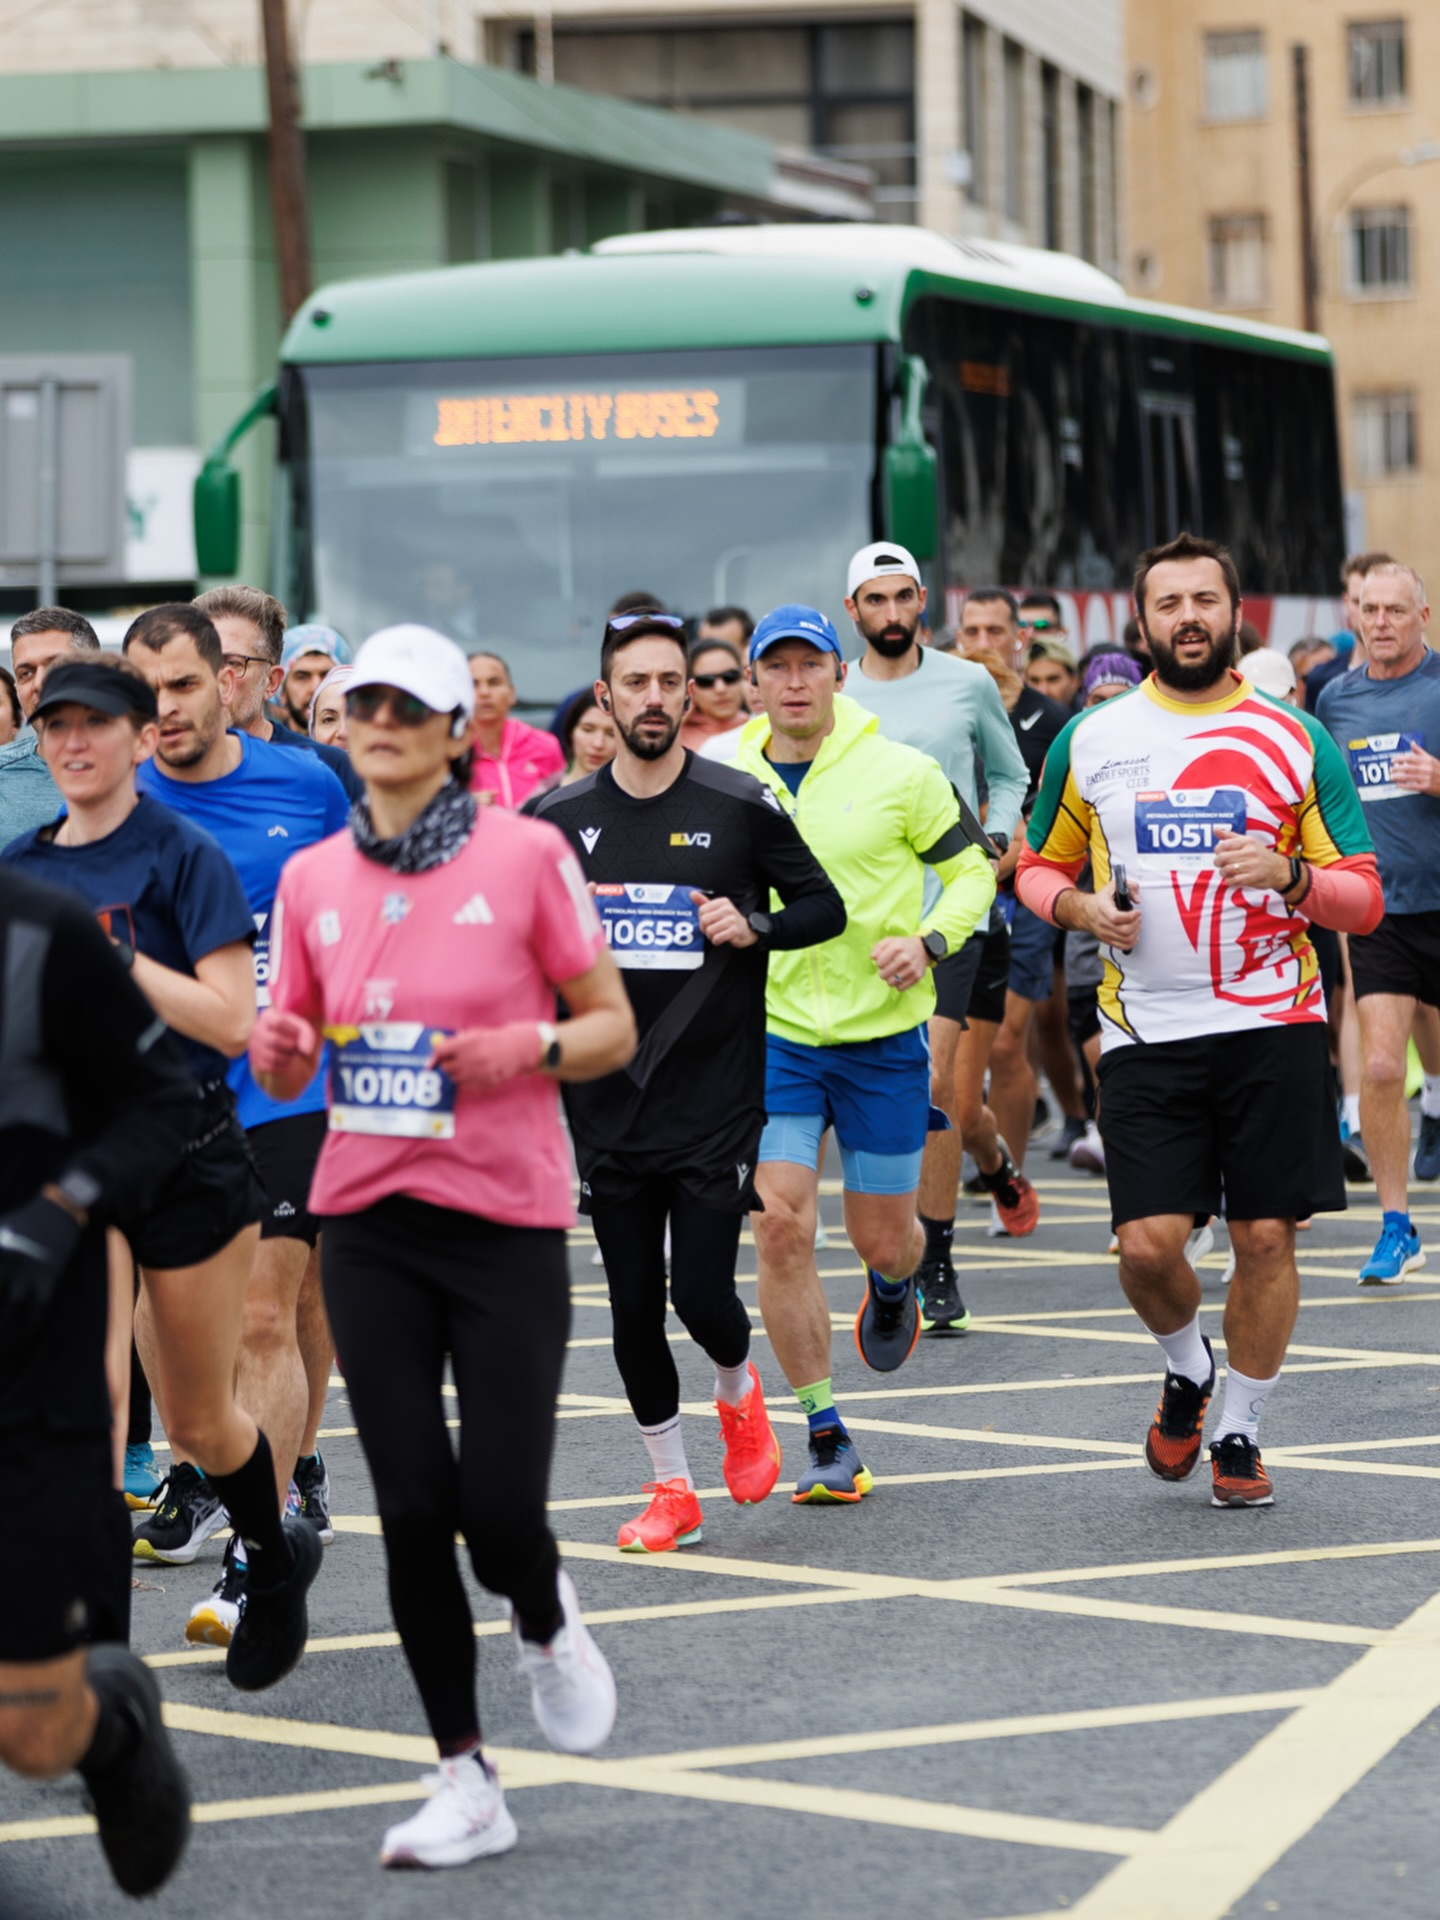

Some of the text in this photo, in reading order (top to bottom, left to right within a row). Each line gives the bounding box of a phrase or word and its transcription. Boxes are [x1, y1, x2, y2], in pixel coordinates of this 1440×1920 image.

[1126, 777, 1150, 789] CLUB
[1359, 761, 1391, 784] 101
[602, 919, 694, 946] 10658
[339, 1067, 442, 1107] 10108
